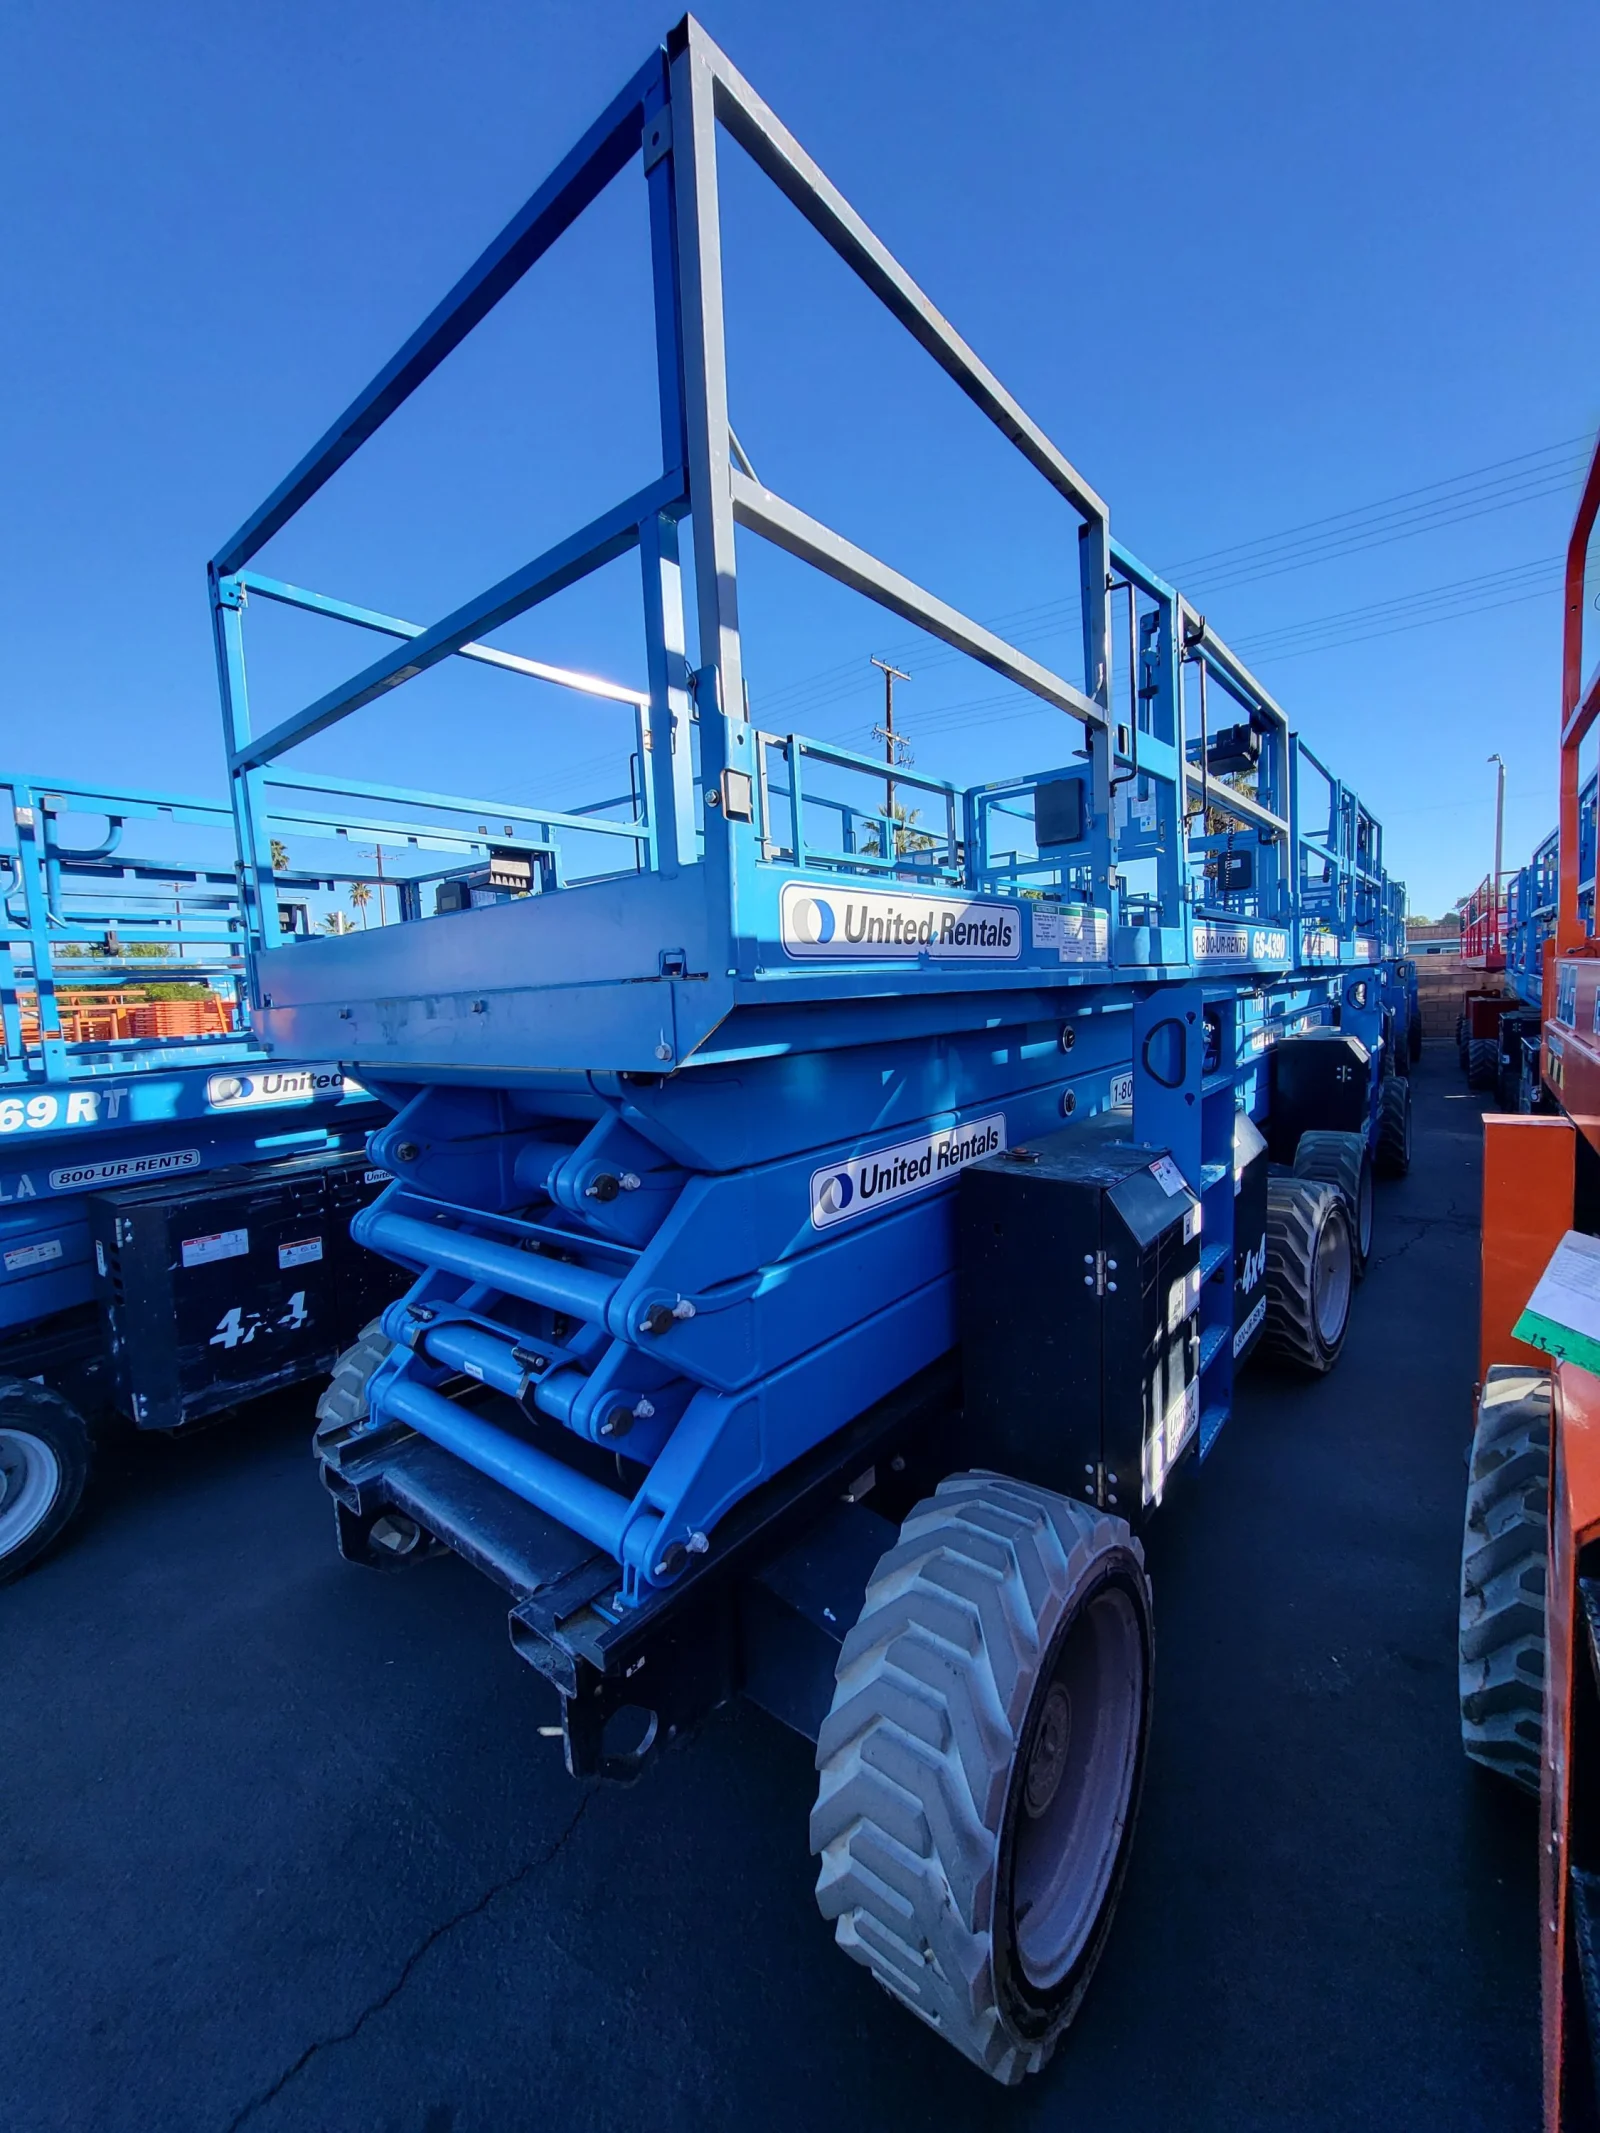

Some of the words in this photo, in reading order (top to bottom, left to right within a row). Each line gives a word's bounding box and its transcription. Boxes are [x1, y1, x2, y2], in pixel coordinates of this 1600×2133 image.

[844, 904, 933, 946] United
[939, 912, 1012, 947] Rentals
[1195, 935, 1246, 953] 1-800-UR-RENTS
[66, 1088, 128, 1124] RT
[58, 1153, 193, 1184] 800-UR-RENTS
[859, 1145, 932, 1199] United
[937, 1126, 999, 1170] Rentals
